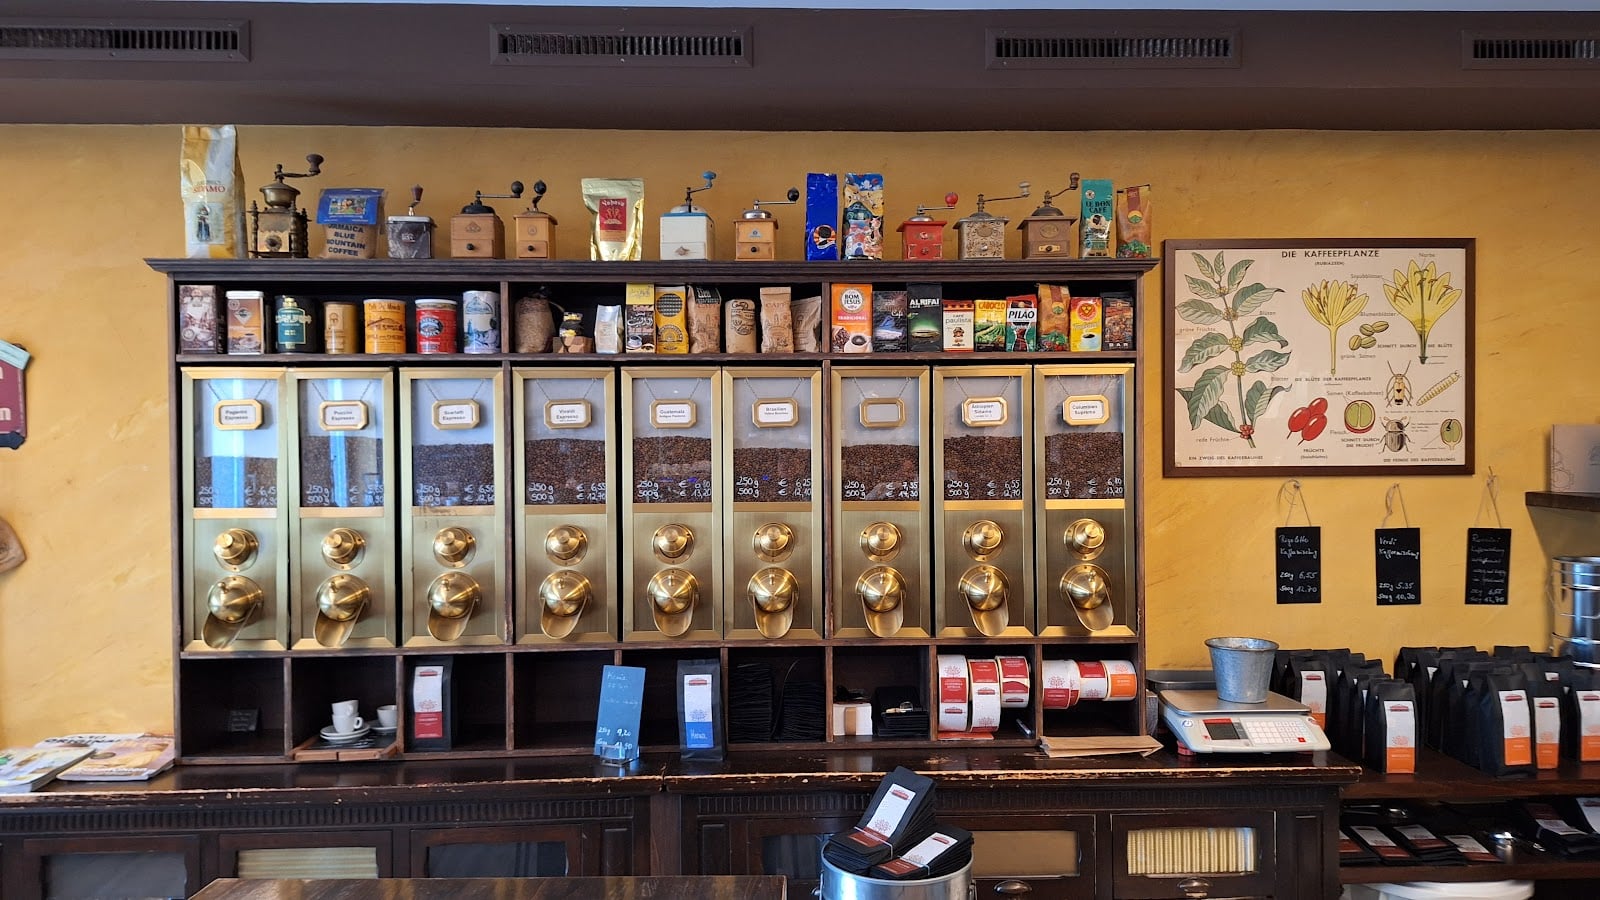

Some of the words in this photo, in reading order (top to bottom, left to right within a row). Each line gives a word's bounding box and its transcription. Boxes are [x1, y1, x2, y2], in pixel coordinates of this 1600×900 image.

[334, 231, 356, 240] BLUE
[328, 246, 359, 257] COFFEE
[1304, 250, 1380, 258] KAFFEEPFLANZE
